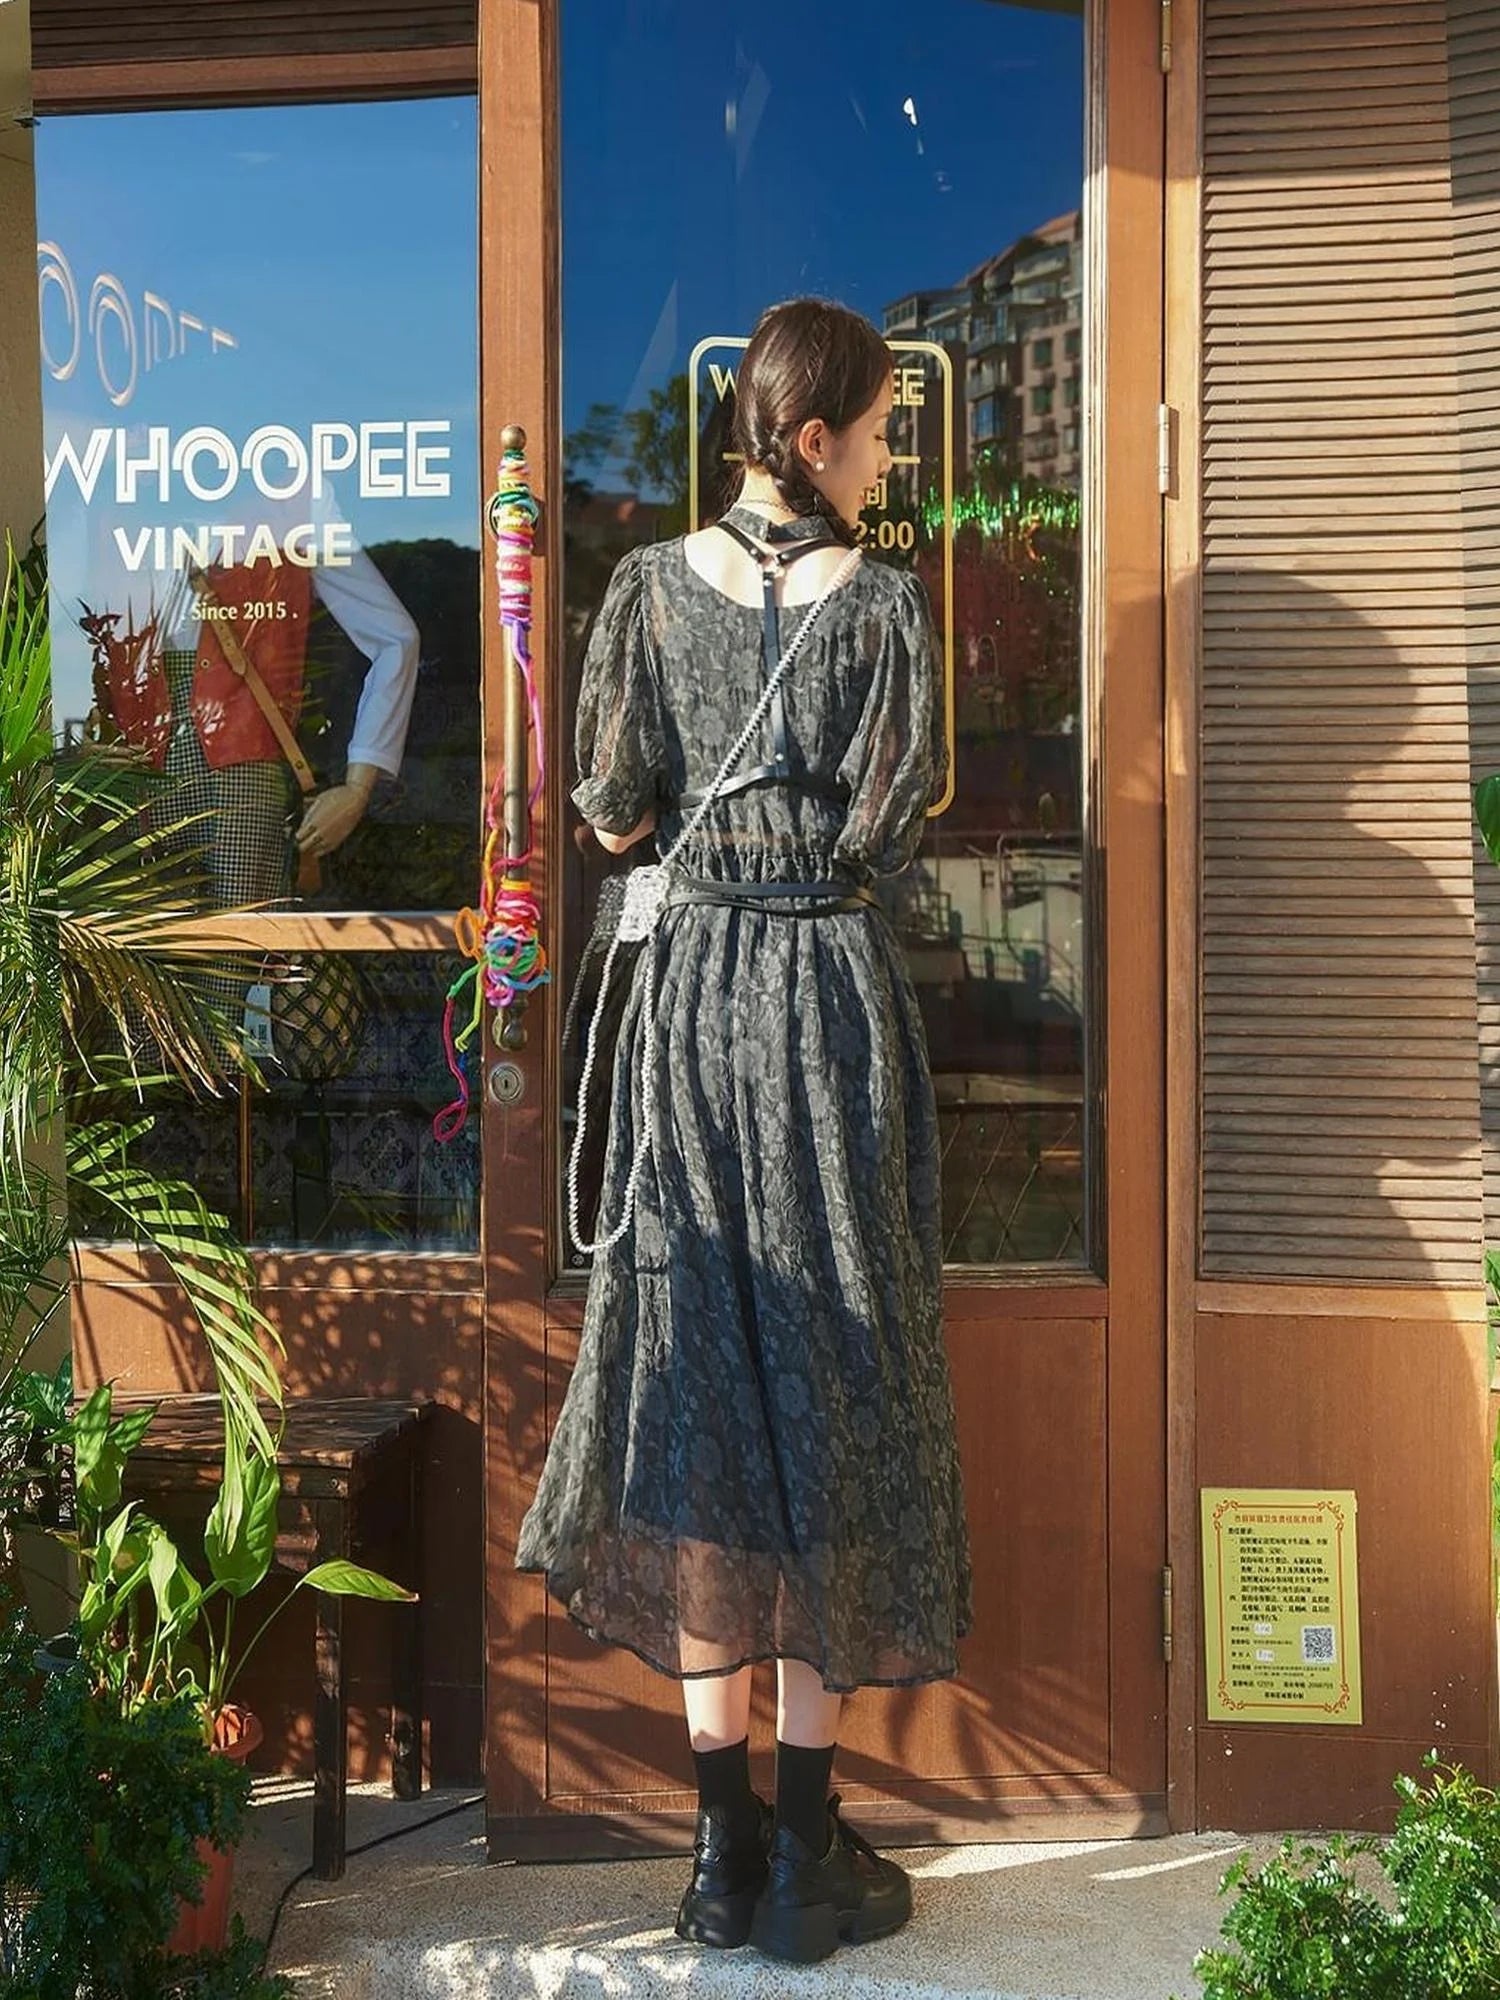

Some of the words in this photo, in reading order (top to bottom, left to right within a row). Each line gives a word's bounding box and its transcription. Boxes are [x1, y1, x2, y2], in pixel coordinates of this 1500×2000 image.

[44, 421, 452, 504] WHOOPEE
[113, 523, 353, 571] VINTAGE
[191, 602, 239, 620] Since
